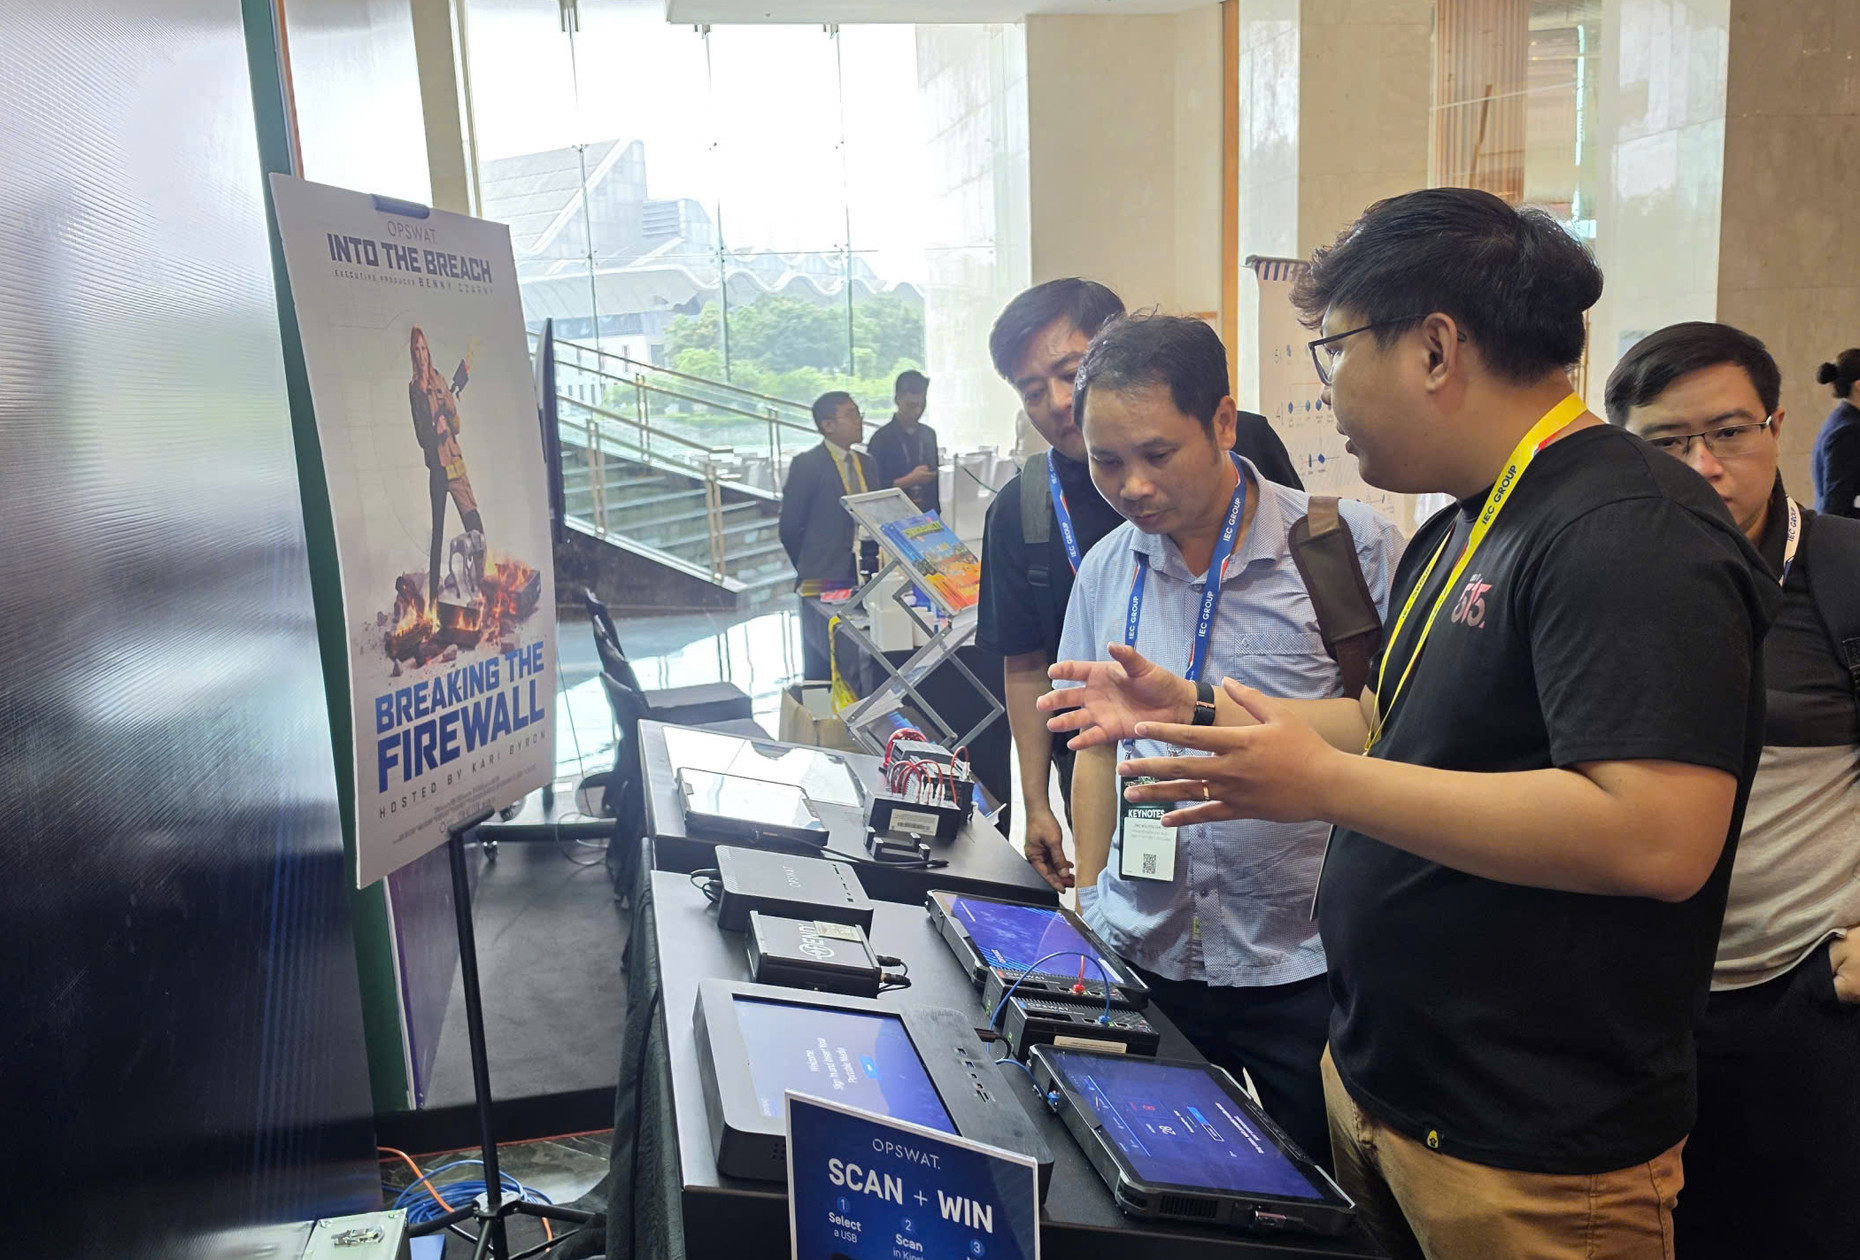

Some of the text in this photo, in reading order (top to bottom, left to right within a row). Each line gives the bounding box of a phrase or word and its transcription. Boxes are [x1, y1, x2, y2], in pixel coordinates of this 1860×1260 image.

[327, 233, 493, 284] INTO THE BREACH
[1481, 464, 1517, 525] IEC GROUP
[1223, 497, 1240, 542] IEC GROUP
[1787, 528, 1796, 542] IEC
[1131, 596, 1139, 624] GROUP
[1198, 591, 1214, 637] IEC GROUP
[375, 641, 545, 735] BREAKING THE
[377, 679, 545, 794] FIREWALL
[379, 782, 437, 819] HOSTED
[447, 769, 462, 786] BY
[472, 753, 500, 774] KARI
[509, 731, 546, 755] BYRON
[828, 1157, 903, 1205] SCAN
[937, 1189, 993, 1234] WIN
[828, 1212, 862, 1232] Select
[833, 1229, 858, 1243] a USB
[895, 1233, 923, 1252] Scan
[905, 1218, 912, 1232] 2
[973, 1241, 981, 1254] 3
